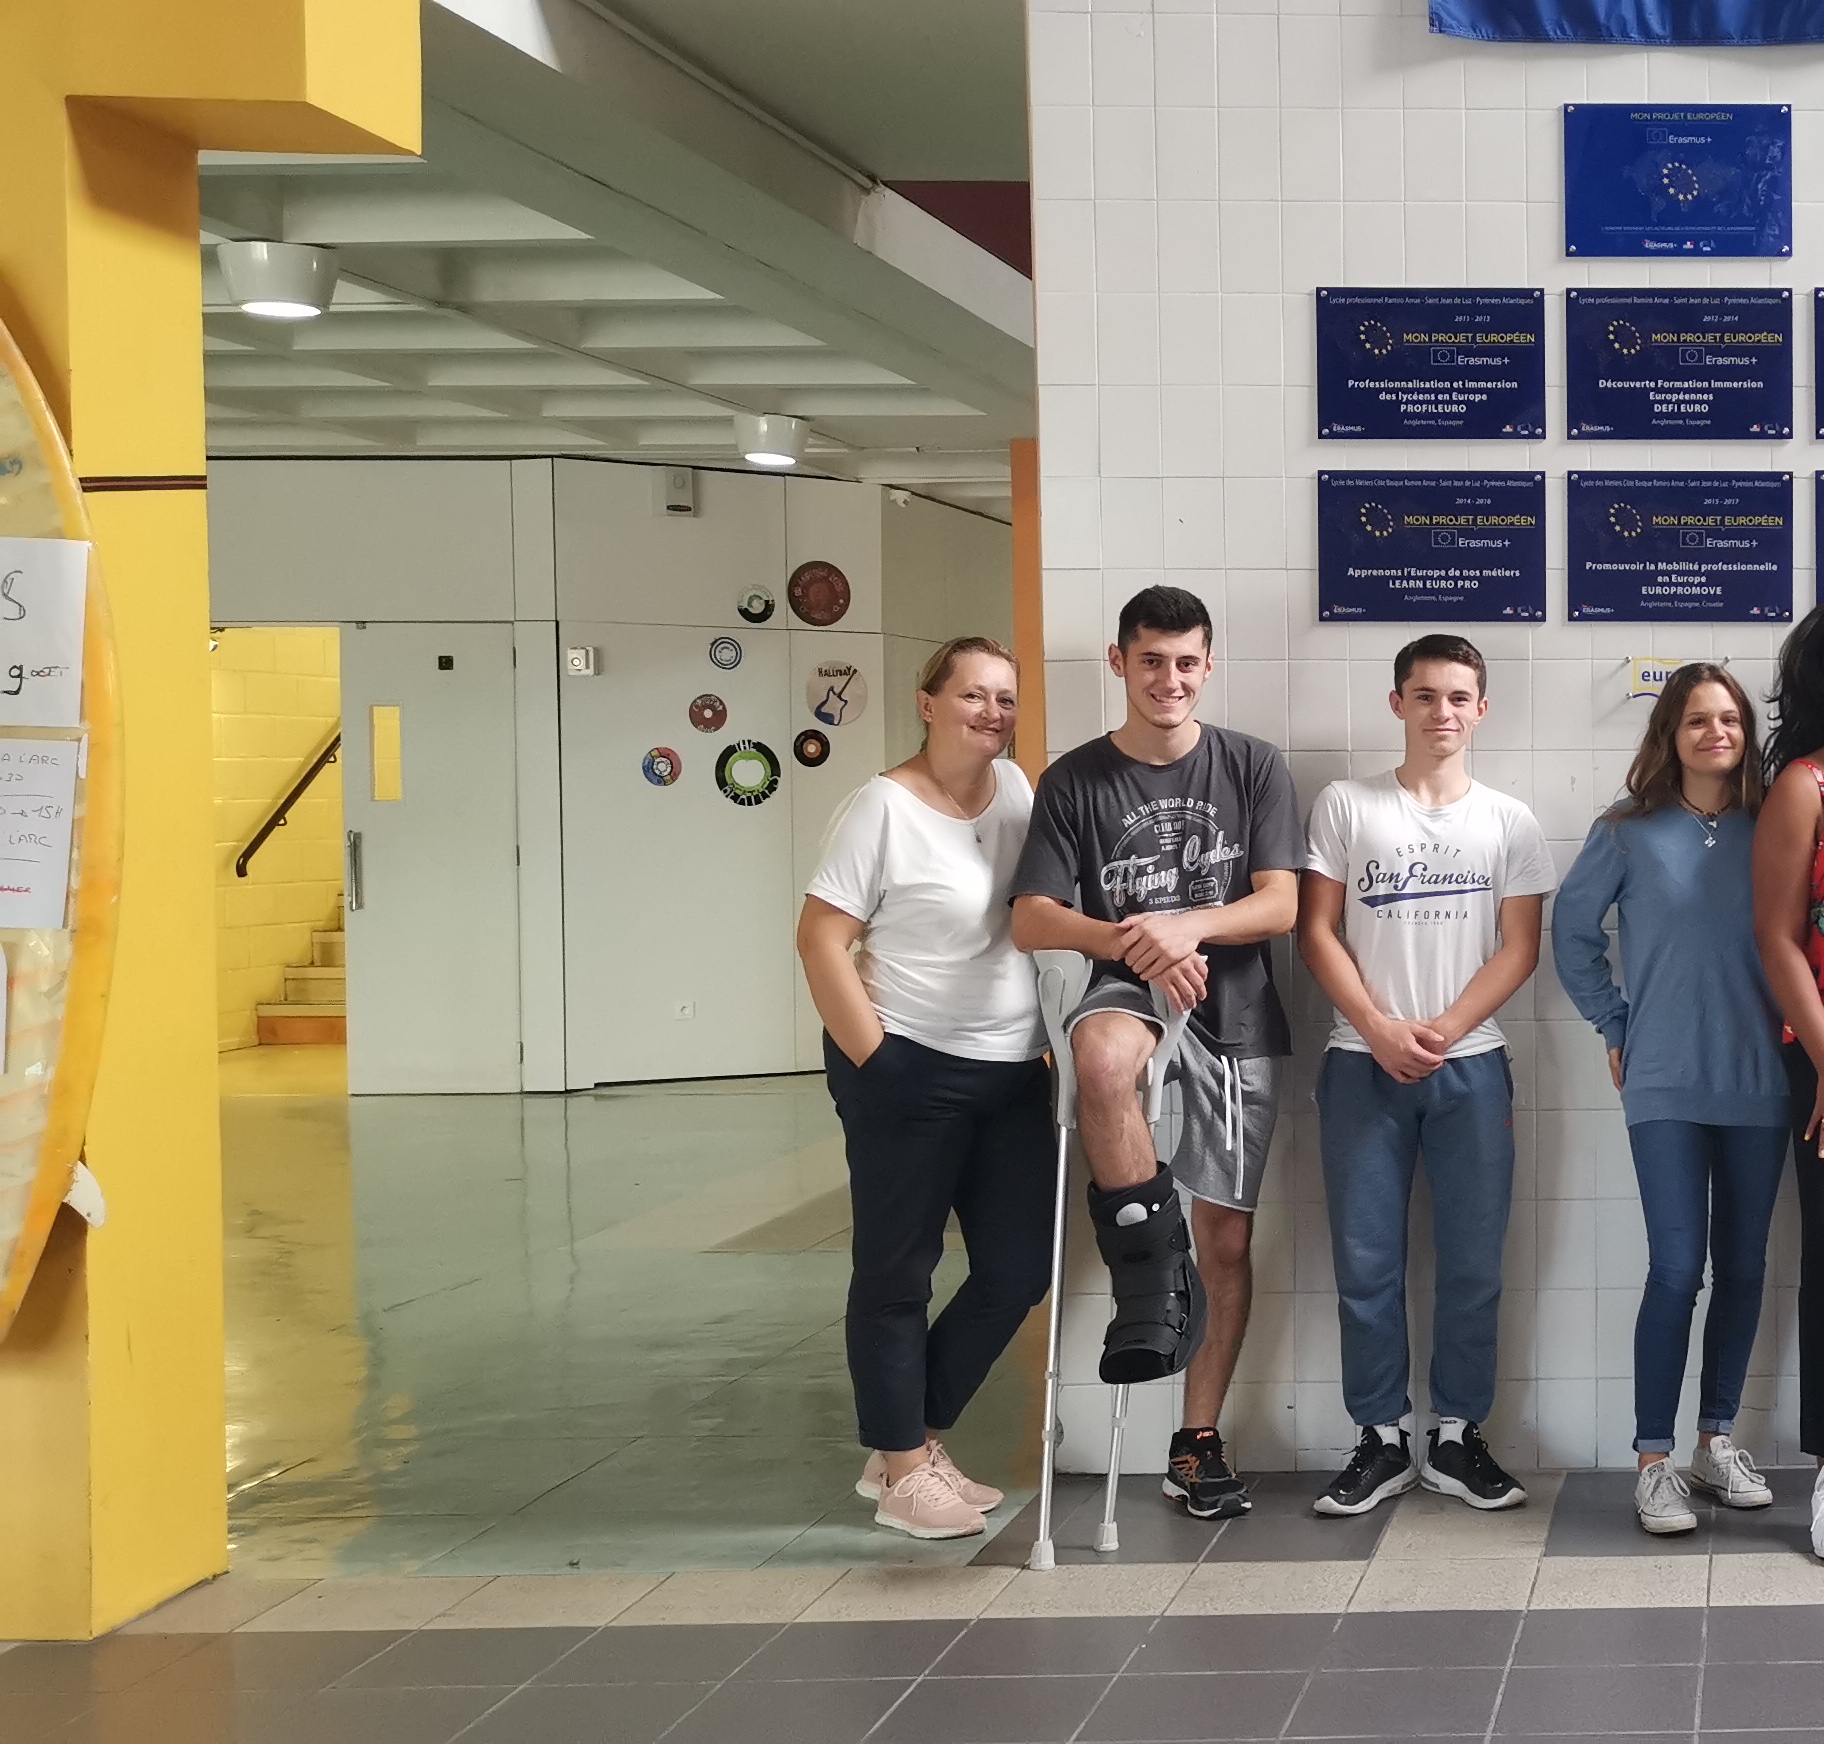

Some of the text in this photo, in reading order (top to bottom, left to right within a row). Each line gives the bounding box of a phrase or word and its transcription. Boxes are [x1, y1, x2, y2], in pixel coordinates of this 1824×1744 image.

[1669, 135, 1712, 144] Erasmus+
[1404, 332, 1535, 342] MON PROJET EUROPÉEN
[1652, 332, 1782, 342] MON PROJET EUROPÉEN
[1458, 356, 1509, 365] Erasmus+
[1706, 356, 1757, 365] Erasmus+
[1348, 379, 1450, 388] Professionnalisation
[1465, 380, 1517, 388] immersion
[1599, 379, 1655, 388] Découverte
[1658, 380, 1708, 388] Formation
[1379, 392, 1396, 400] des
[1399, 392, 1434, 402] lycéens
[1452, 393, 1487, 402] Europe
[1650, 392, 1713, 402] Européennes
[1401, 404, 1466, 412] PROFILEURO
[1654, 404, 1708, 412] DEFI EURO
[1404, 514, 1535, 525] MON PROJET EUROPÉEN
[1653, 515, 1782, 525] MON PROJET EUROPÉEN
[1459, 538, 1511, 547] Erasmus+
[1707, 538, 1758, 548] Erasmus+
[1586, 562, 1777, 572] Promouvoir la Mobilité professionnelle
[1348, 568, 1401, 577] Apprenons
[1404, 568, 1446, 578] l'Europe
[1448, 568, 1460, 576] de
[1389, 580, 1478, 588] LEARN EURO PRO
[1672, 575, 1706, 584] Europe
[1642, 671, 1672, 681] eur
[1122, 798, 1218, 828] ALL THE WORLD RIDE
[1396, 843, 1461, 858] ESPRIT
[1101, 855, 1179, 907] Flying
[1358, 860, 1403, 892] San
[1377, 910, 1468, 920] CALIFORNIA
